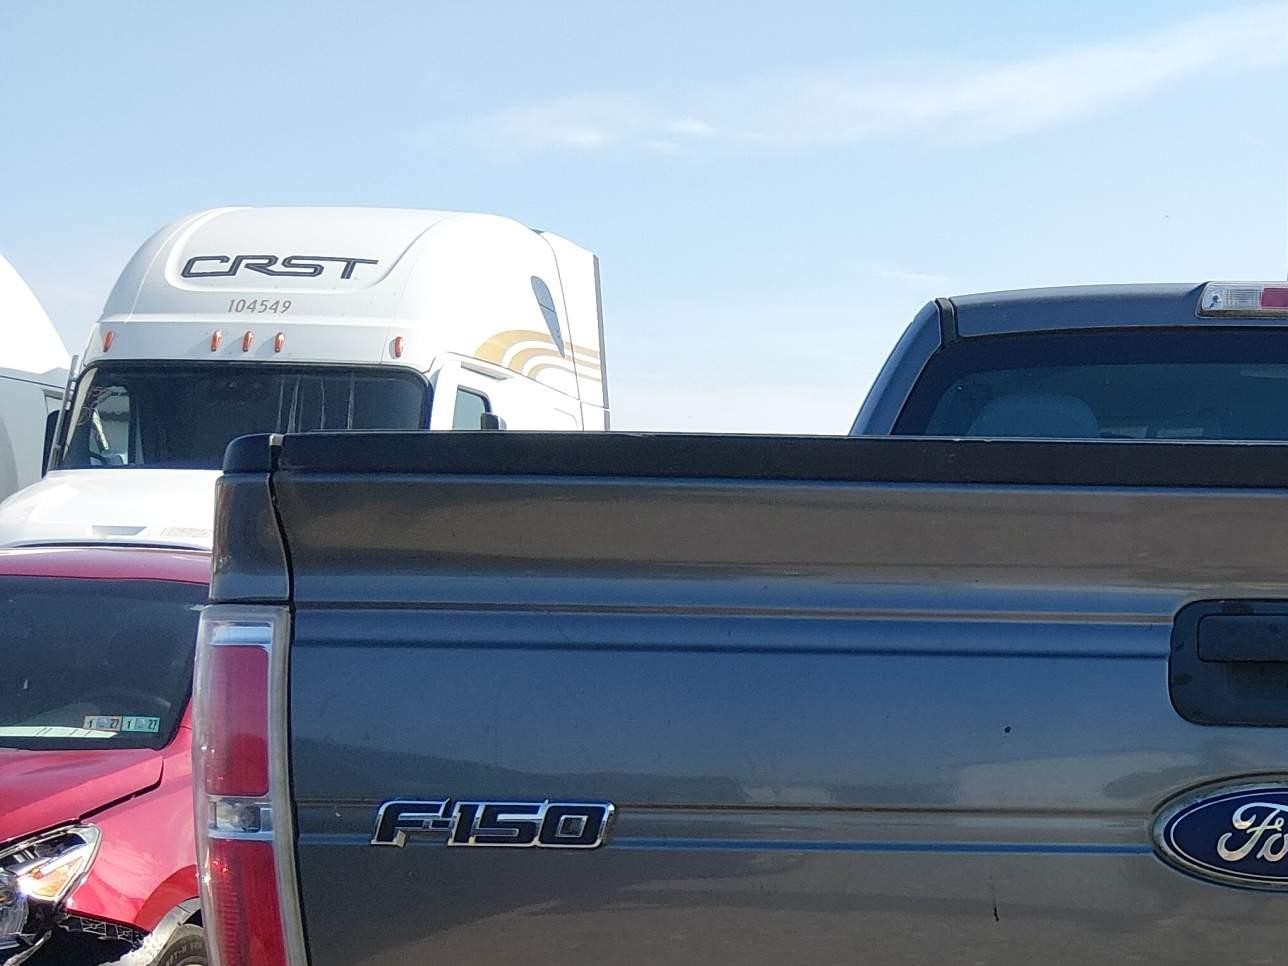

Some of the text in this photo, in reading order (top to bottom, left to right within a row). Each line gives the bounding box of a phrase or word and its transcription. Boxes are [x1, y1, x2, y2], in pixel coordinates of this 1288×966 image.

[181, 255, 379, 279] CRST
[227, 299, 291, 314] 104549
[371, 799, 615, 849] F-150
